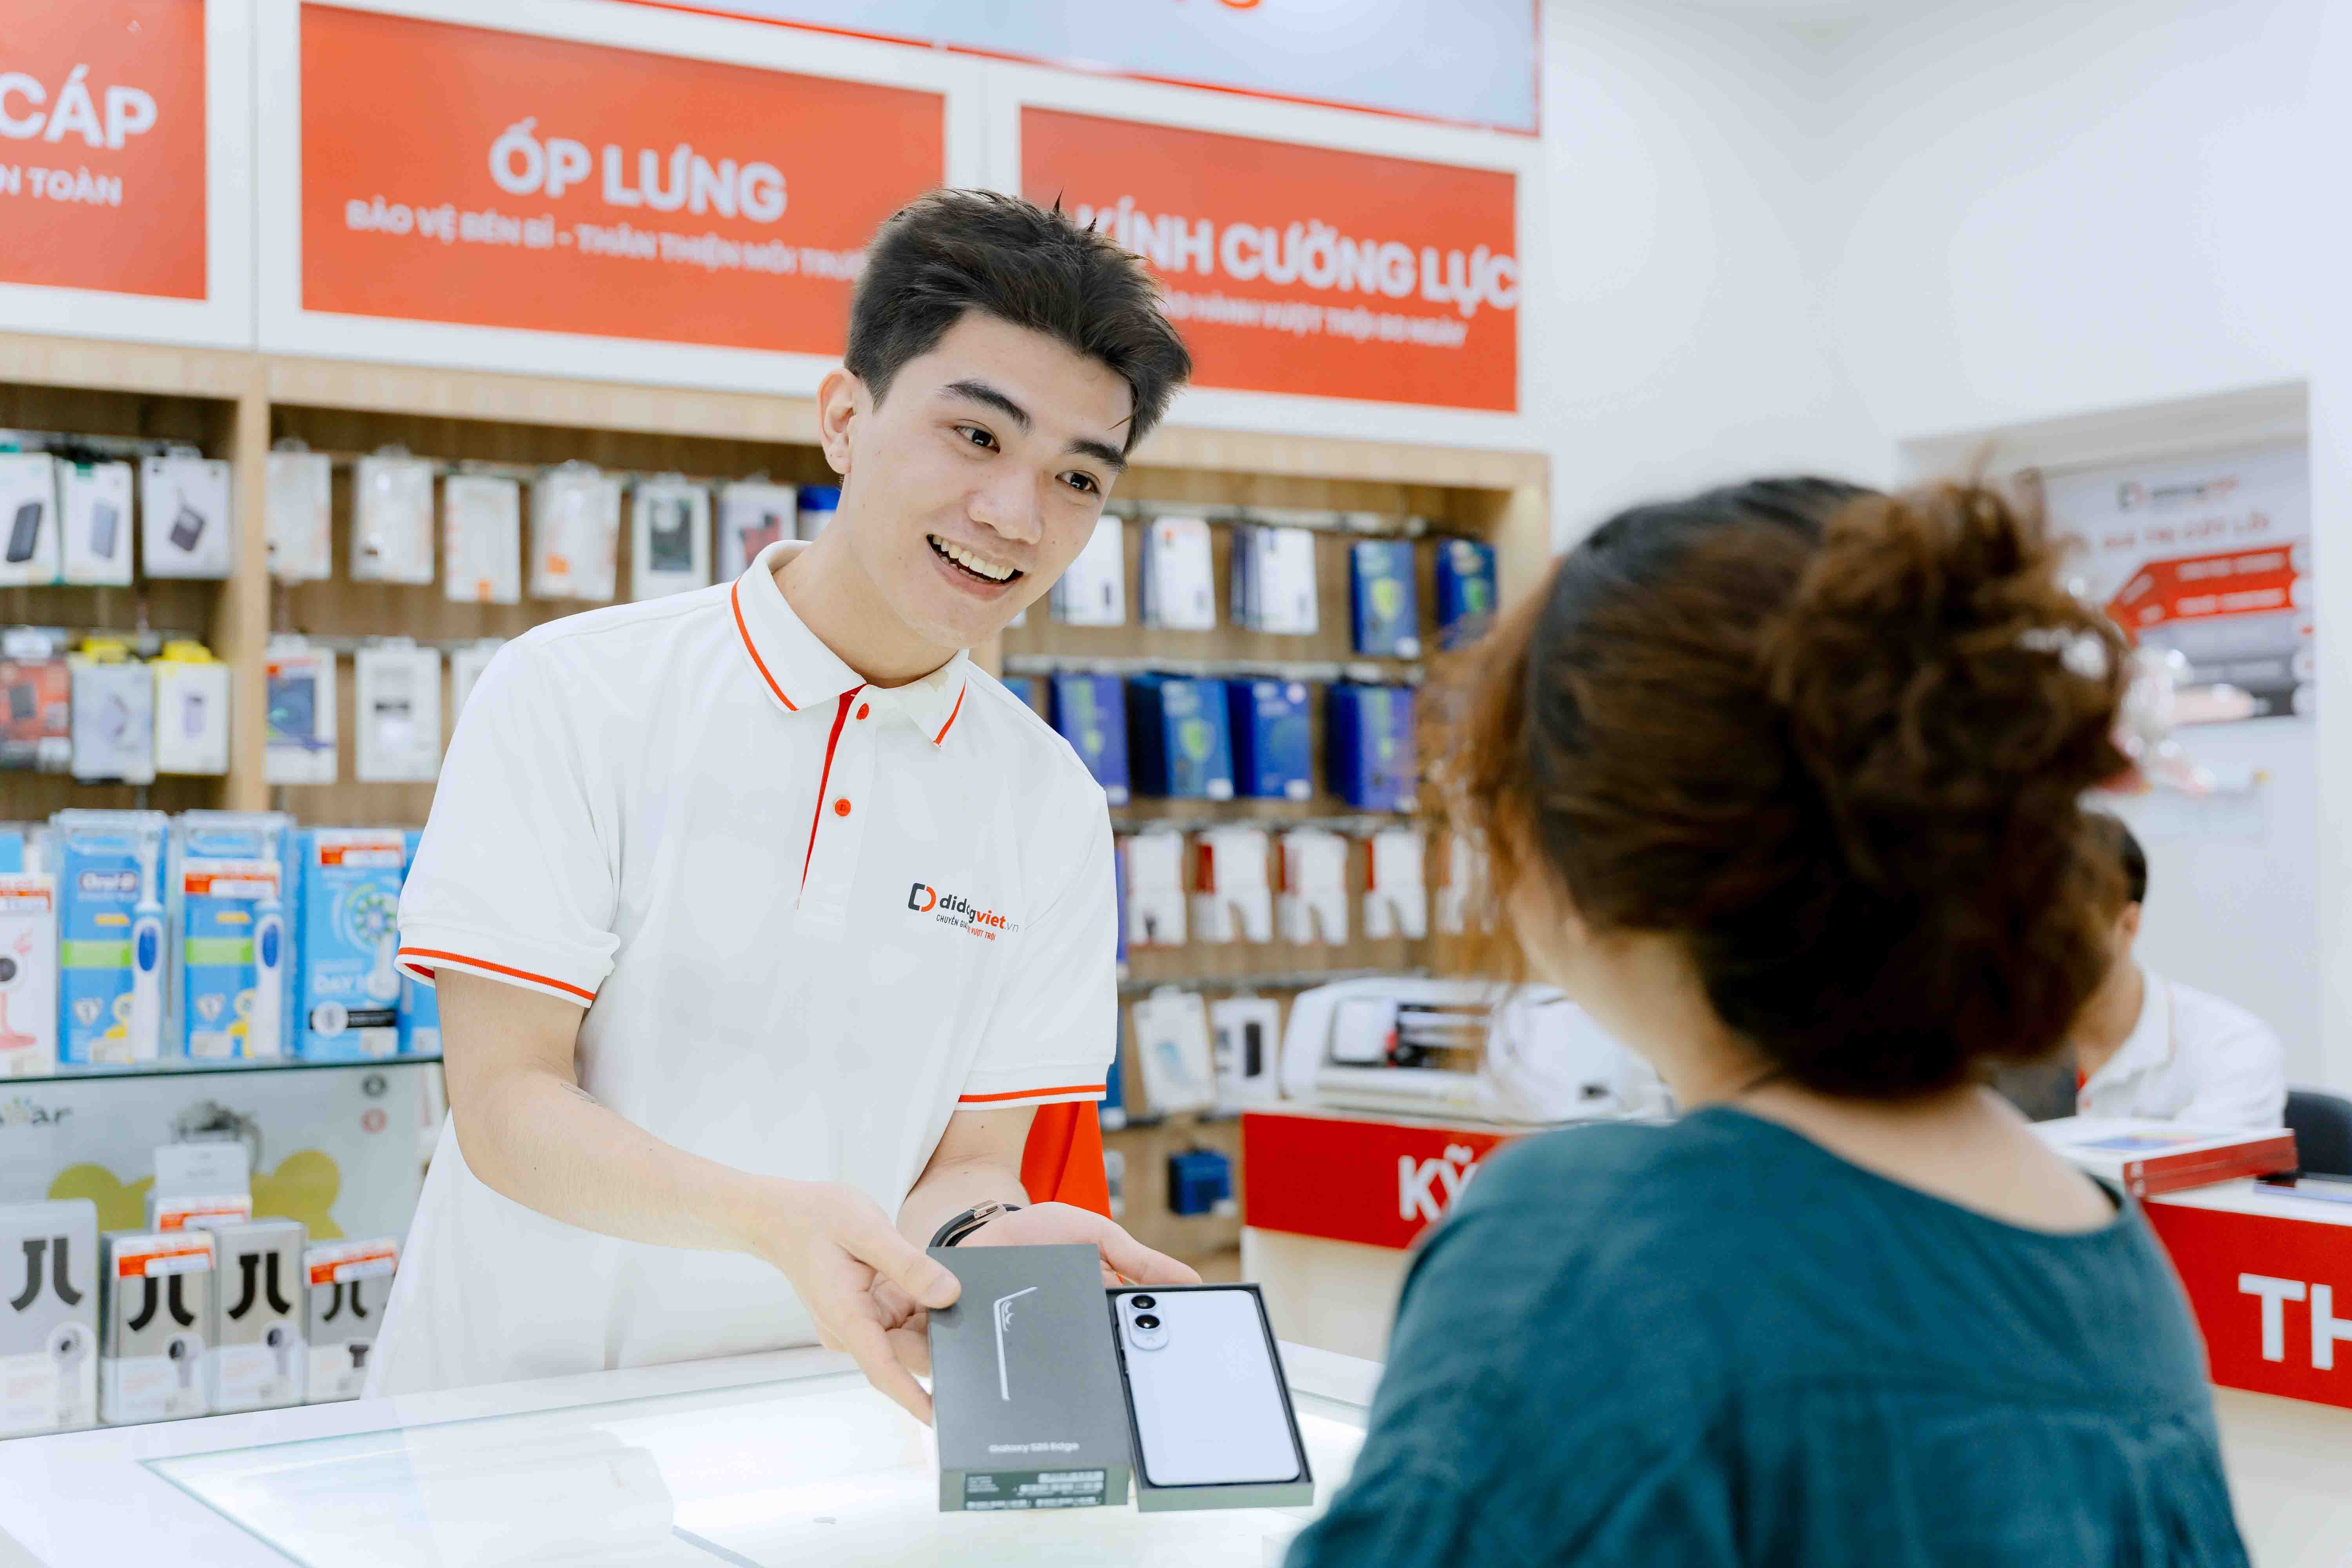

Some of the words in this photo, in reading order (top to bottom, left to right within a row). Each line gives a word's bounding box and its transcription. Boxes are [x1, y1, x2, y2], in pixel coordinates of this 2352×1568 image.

[0, 63, 158, 150] CÁP
[26, 165, 123, 208] TOÀN
[488, 116, 593, 199] ỐP
[1220, 216, 1416, 299] CƯỜNG
[1418, 243, 1523, 319] LỰC
